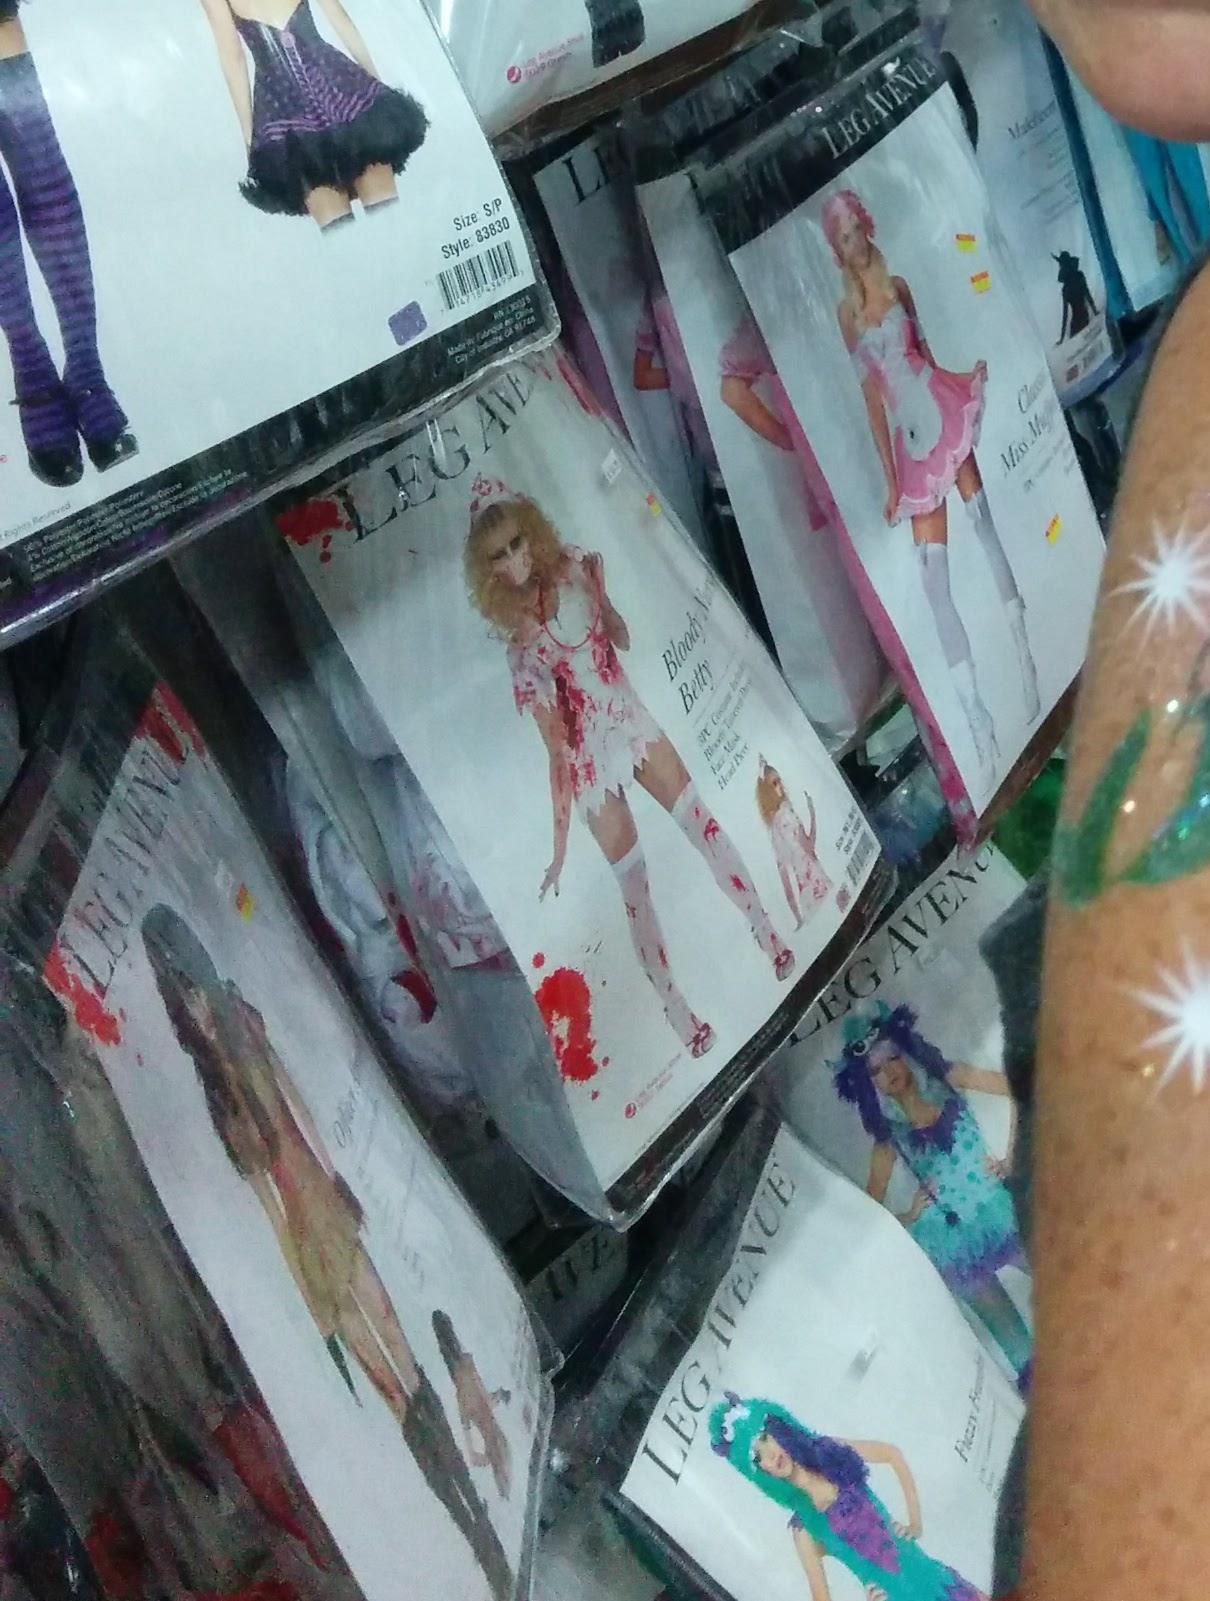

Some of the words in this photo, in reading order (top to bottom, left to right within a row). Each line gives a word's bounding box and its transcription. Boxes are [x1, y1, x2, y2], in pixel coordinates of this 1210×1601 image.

[822, 108, 871, 160] LEG
[475, 216, 511, 243] 83830
[483, 197, 503, 217] S/P
[333, 424, 471, 545] LEG
[661, 611, 707, 682] Bloody
[678, 659, 714, 716] Betty
[642, 1361, 711, 1486] LEG
[706, 1162, 796, 1376] AVENUE
